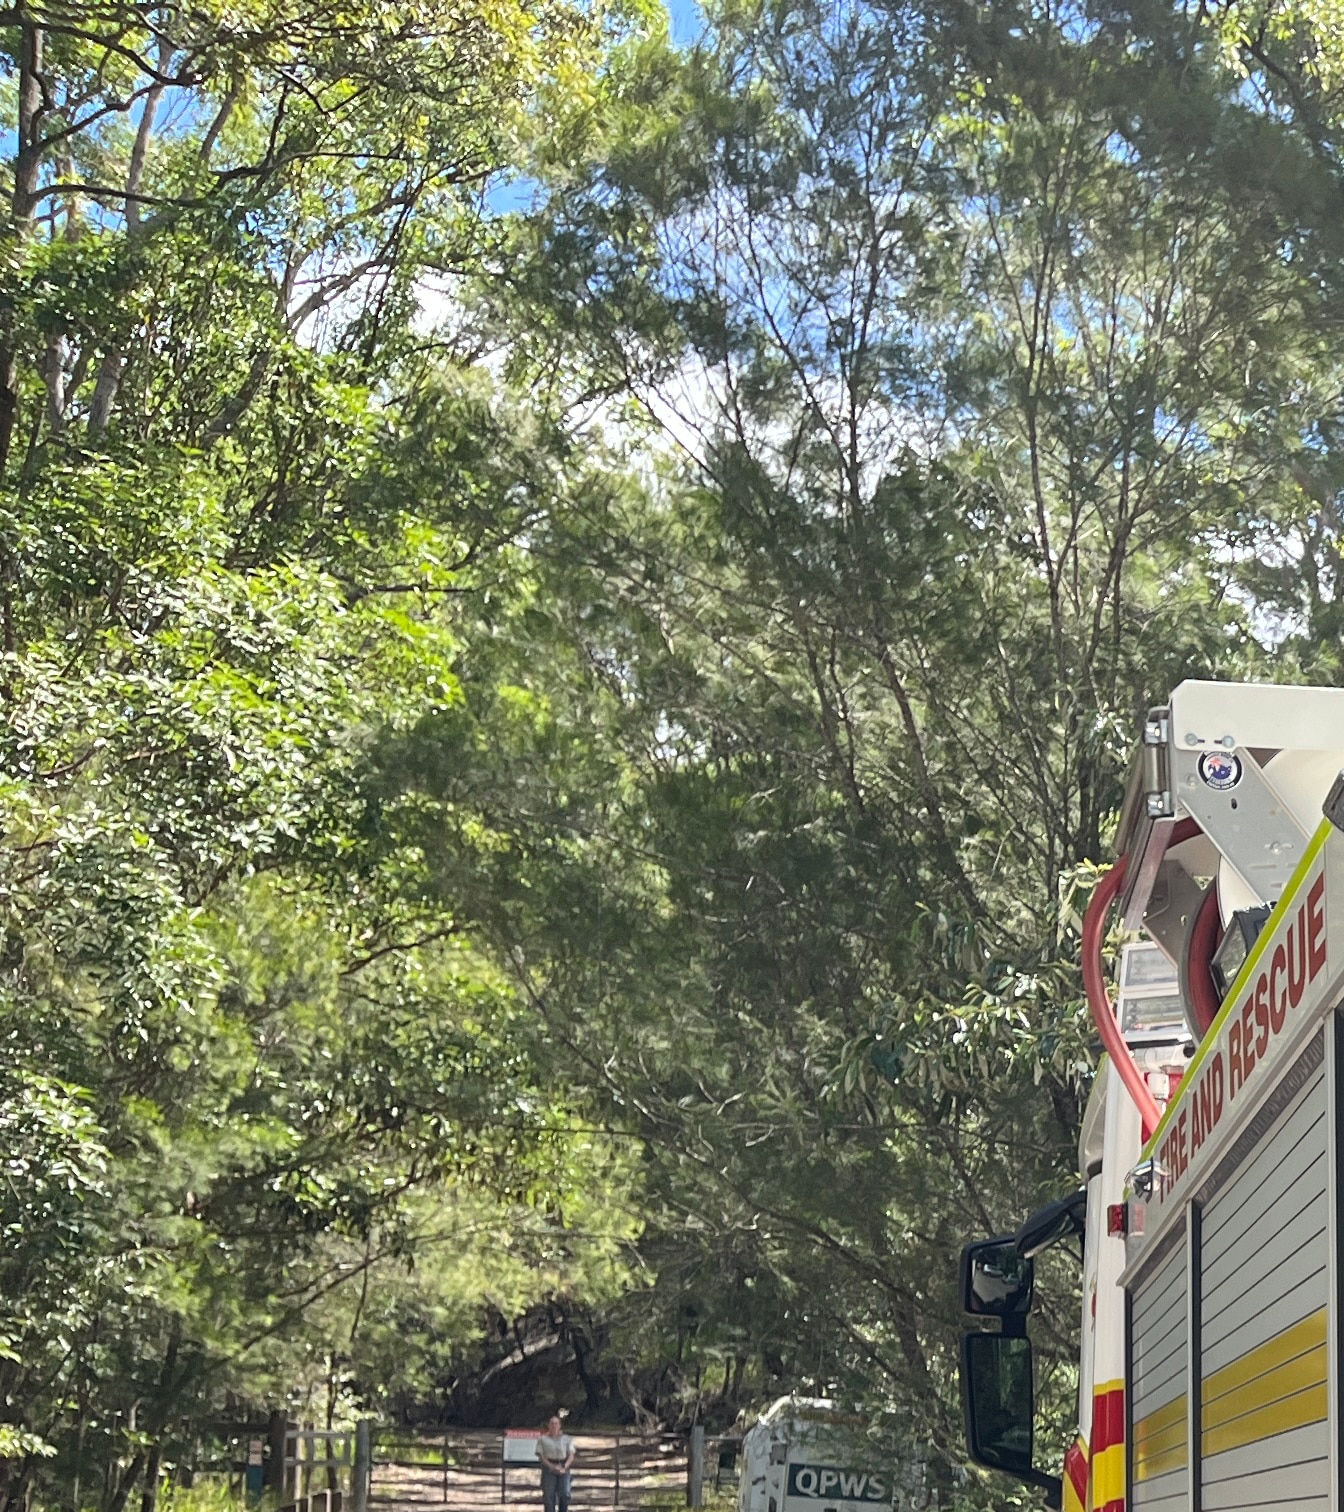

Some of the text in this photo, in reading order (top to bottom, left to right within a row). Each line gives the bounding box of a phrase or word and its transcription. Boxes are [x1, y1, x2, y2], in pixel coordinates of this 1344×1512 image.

[1160, 871, 1327, 1205] FIRE AND RESCUE
[795, 1468, 887, 1499] QPWS
